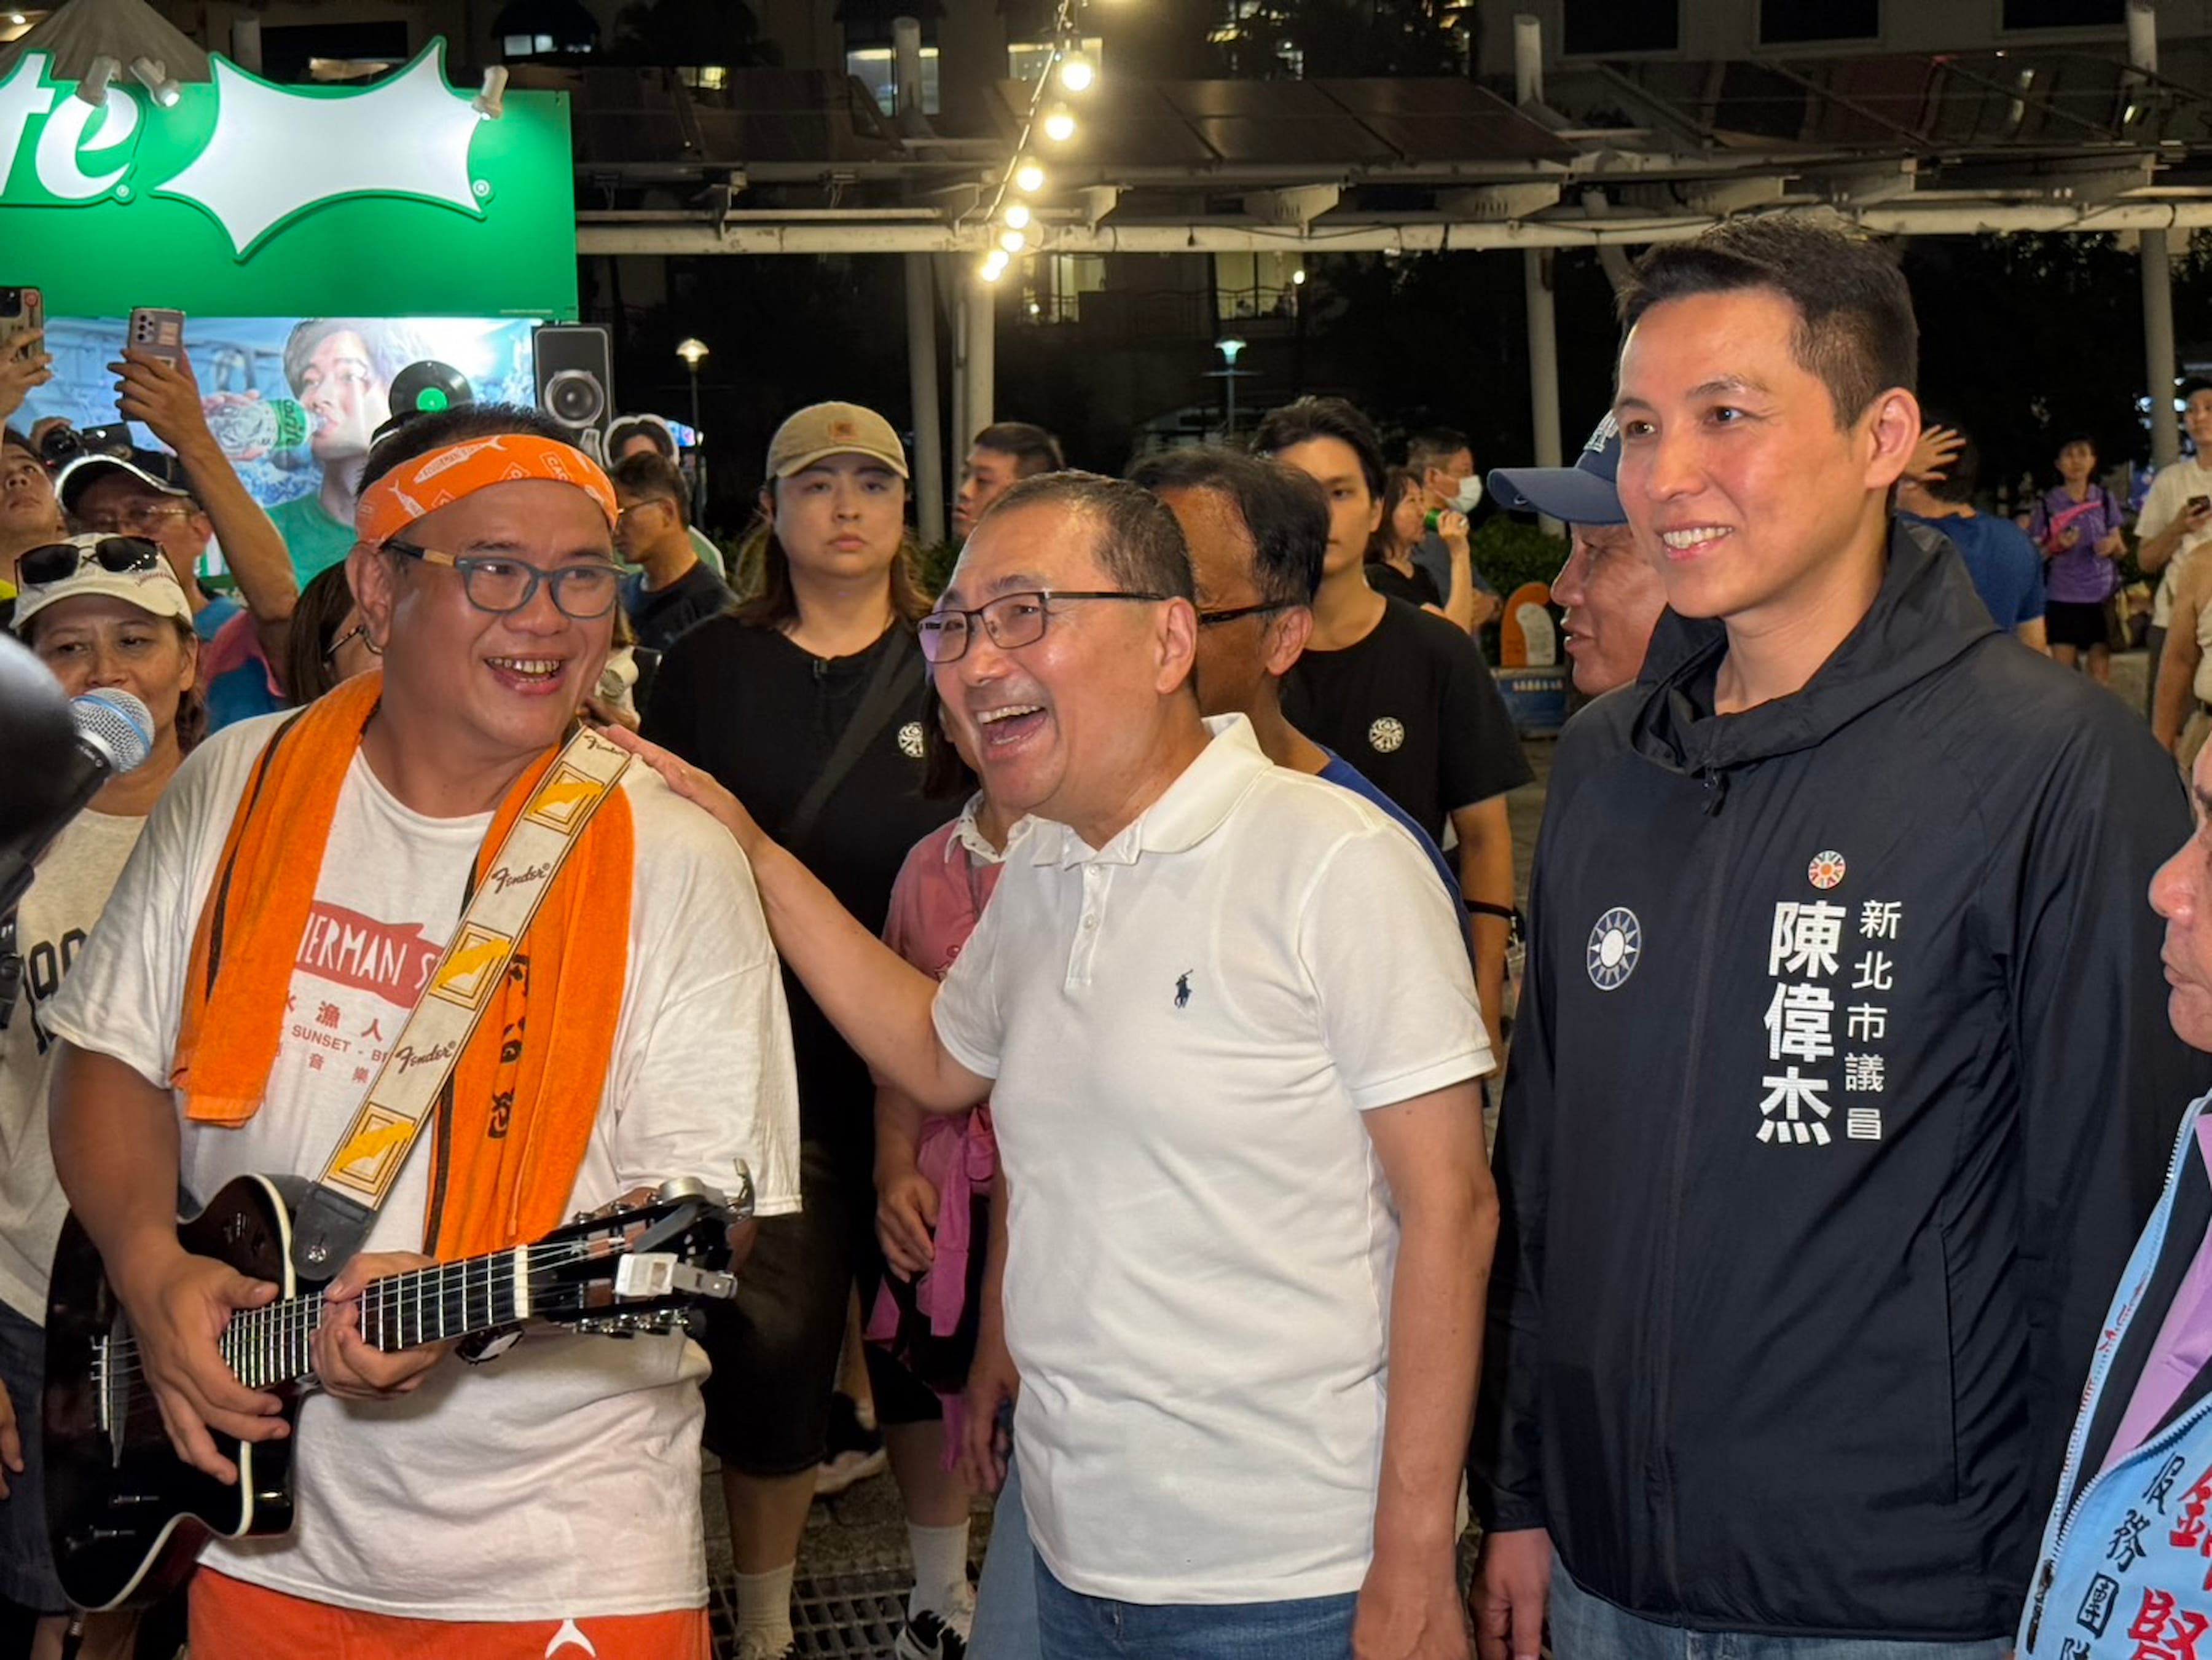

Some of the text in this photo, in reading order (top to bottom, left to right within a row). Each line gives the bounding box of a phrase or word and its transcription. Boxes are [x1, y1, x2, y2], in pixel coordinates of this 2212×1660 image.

[291, 1025, 351, 1053] SUNSET
[1755, 900, 1847, 1147] 陳偉杰
[1844, 899, 1902, 1141] 新北市議員
